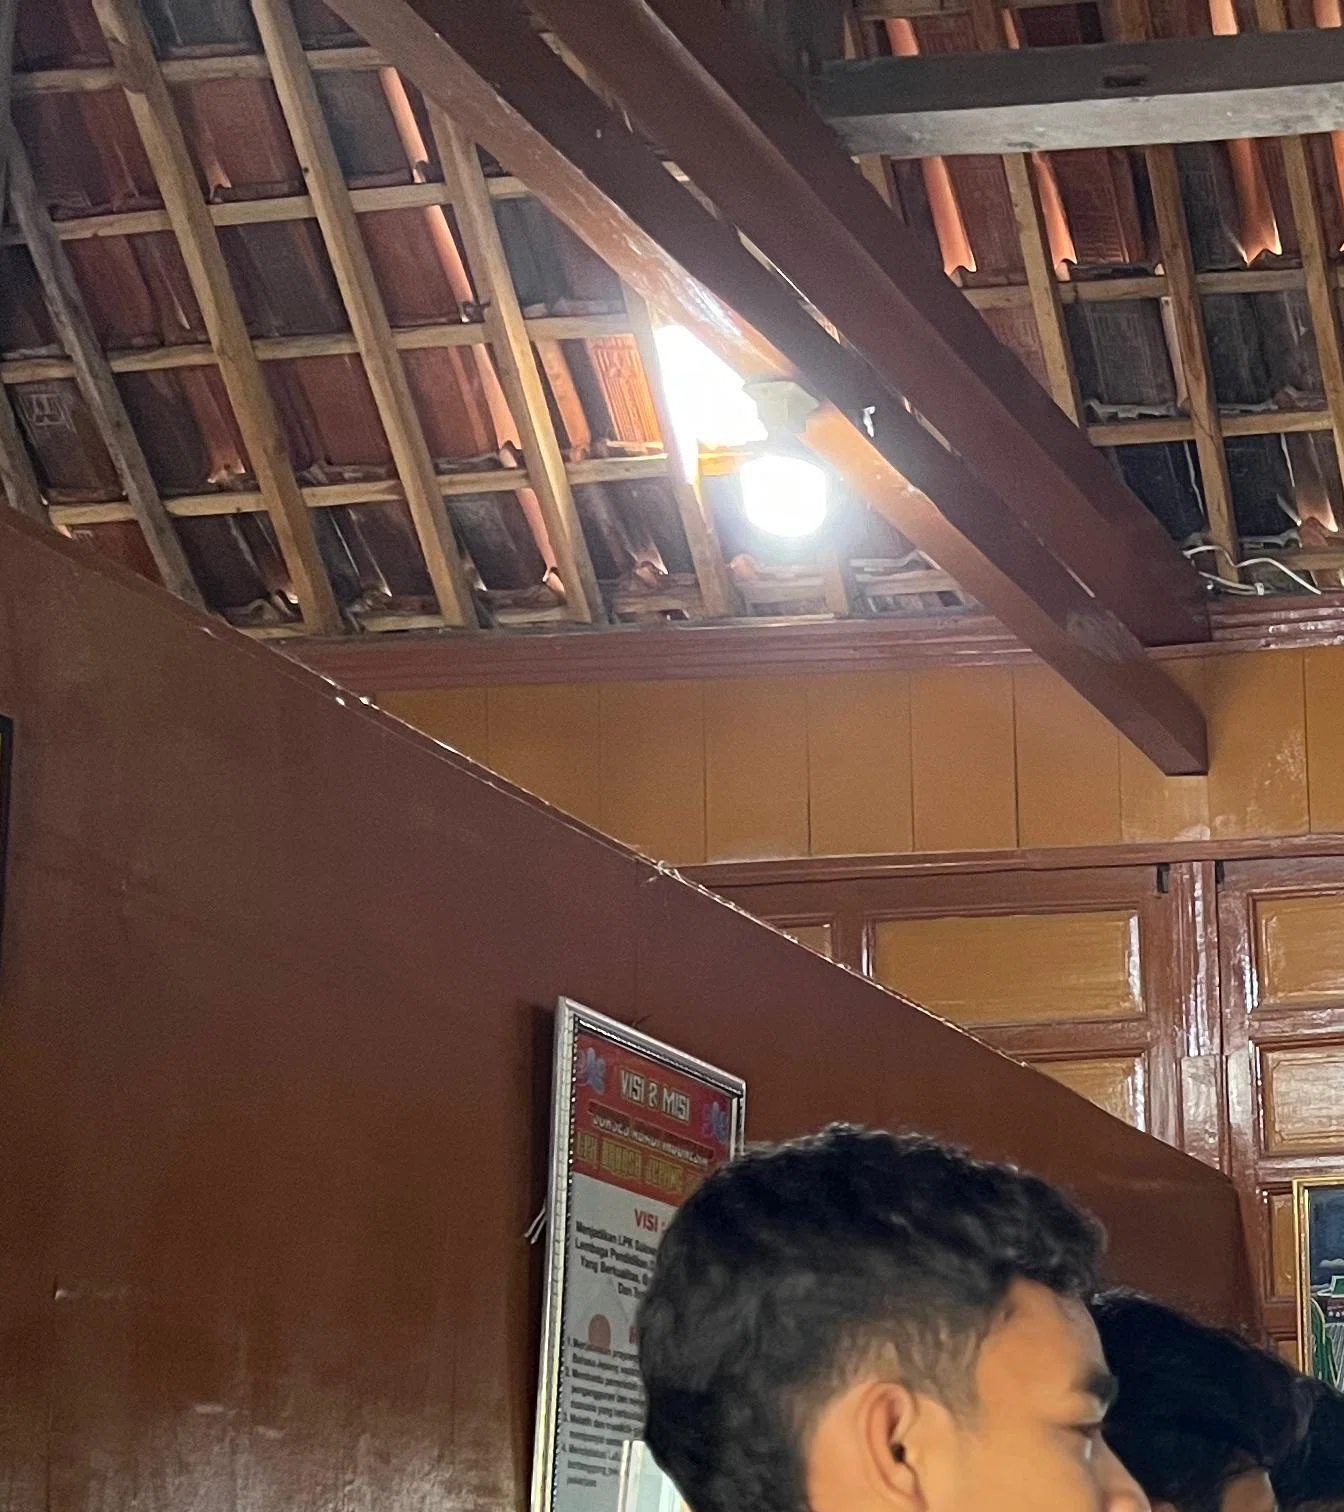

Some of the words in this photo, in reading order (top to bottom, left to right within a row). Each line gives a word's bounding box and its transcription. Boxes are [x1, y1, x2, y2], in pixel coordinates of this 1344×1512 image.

[620, 1069, 645, 1102] VISI
[663, 1086, 691, 1122] MISI
[634, 1208, 658, 1232] VISI
